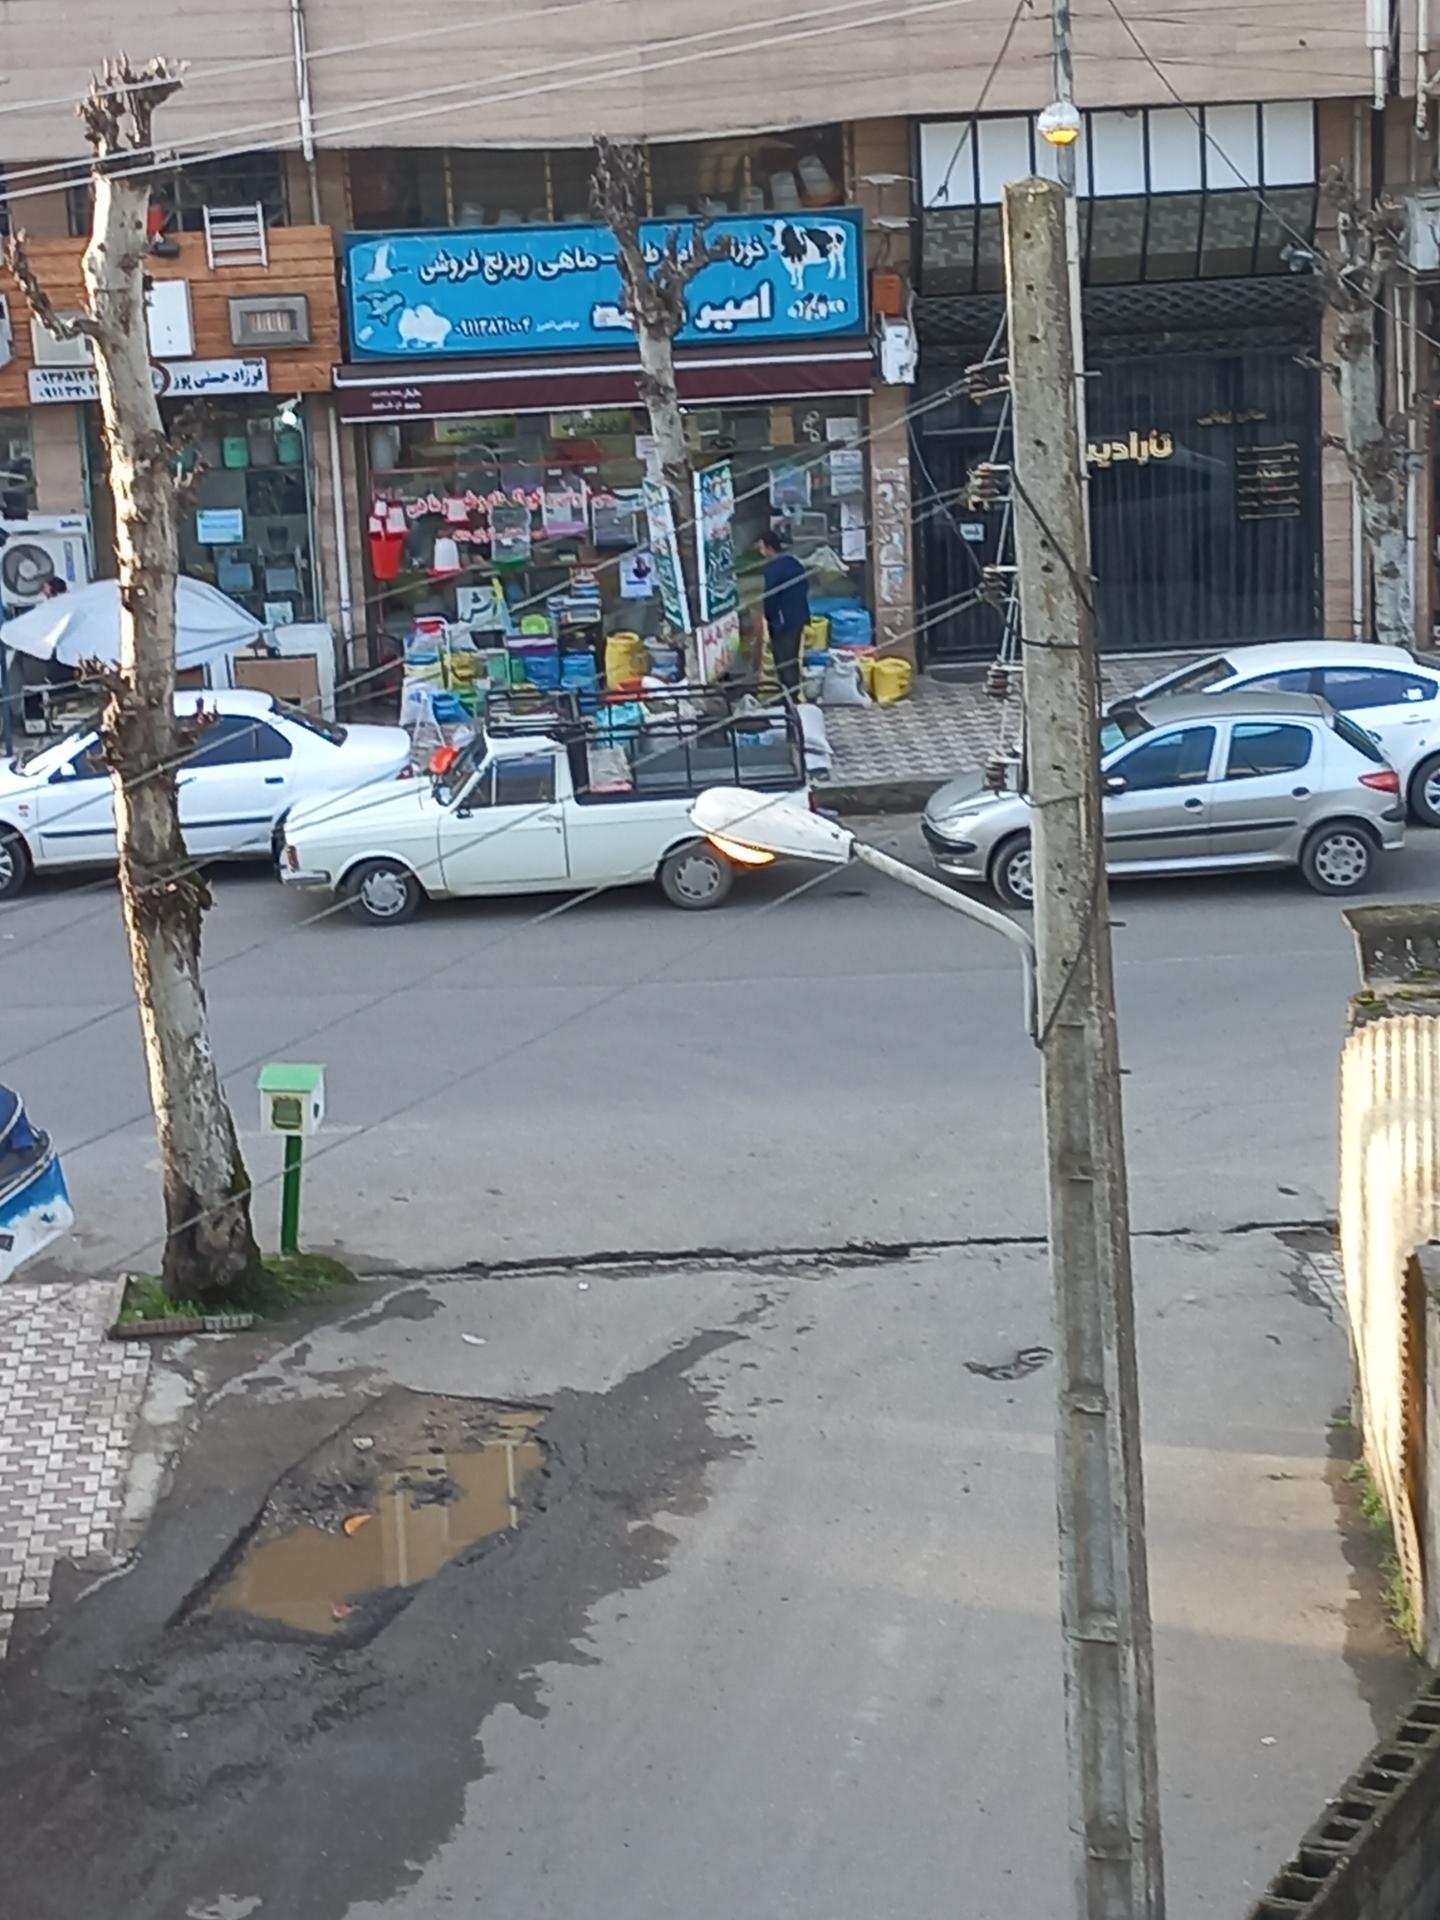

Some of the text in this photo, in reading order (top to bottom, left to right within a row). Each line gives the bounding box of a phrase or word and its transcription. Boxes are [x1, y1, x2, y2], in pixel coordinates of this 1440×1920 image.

[419, 247, 479, 283] فروشی
[537, 246, 599, 278] ماهی
[694, 281, 772, 331] امیر
[231, 367, 263, 387] فرزاد
